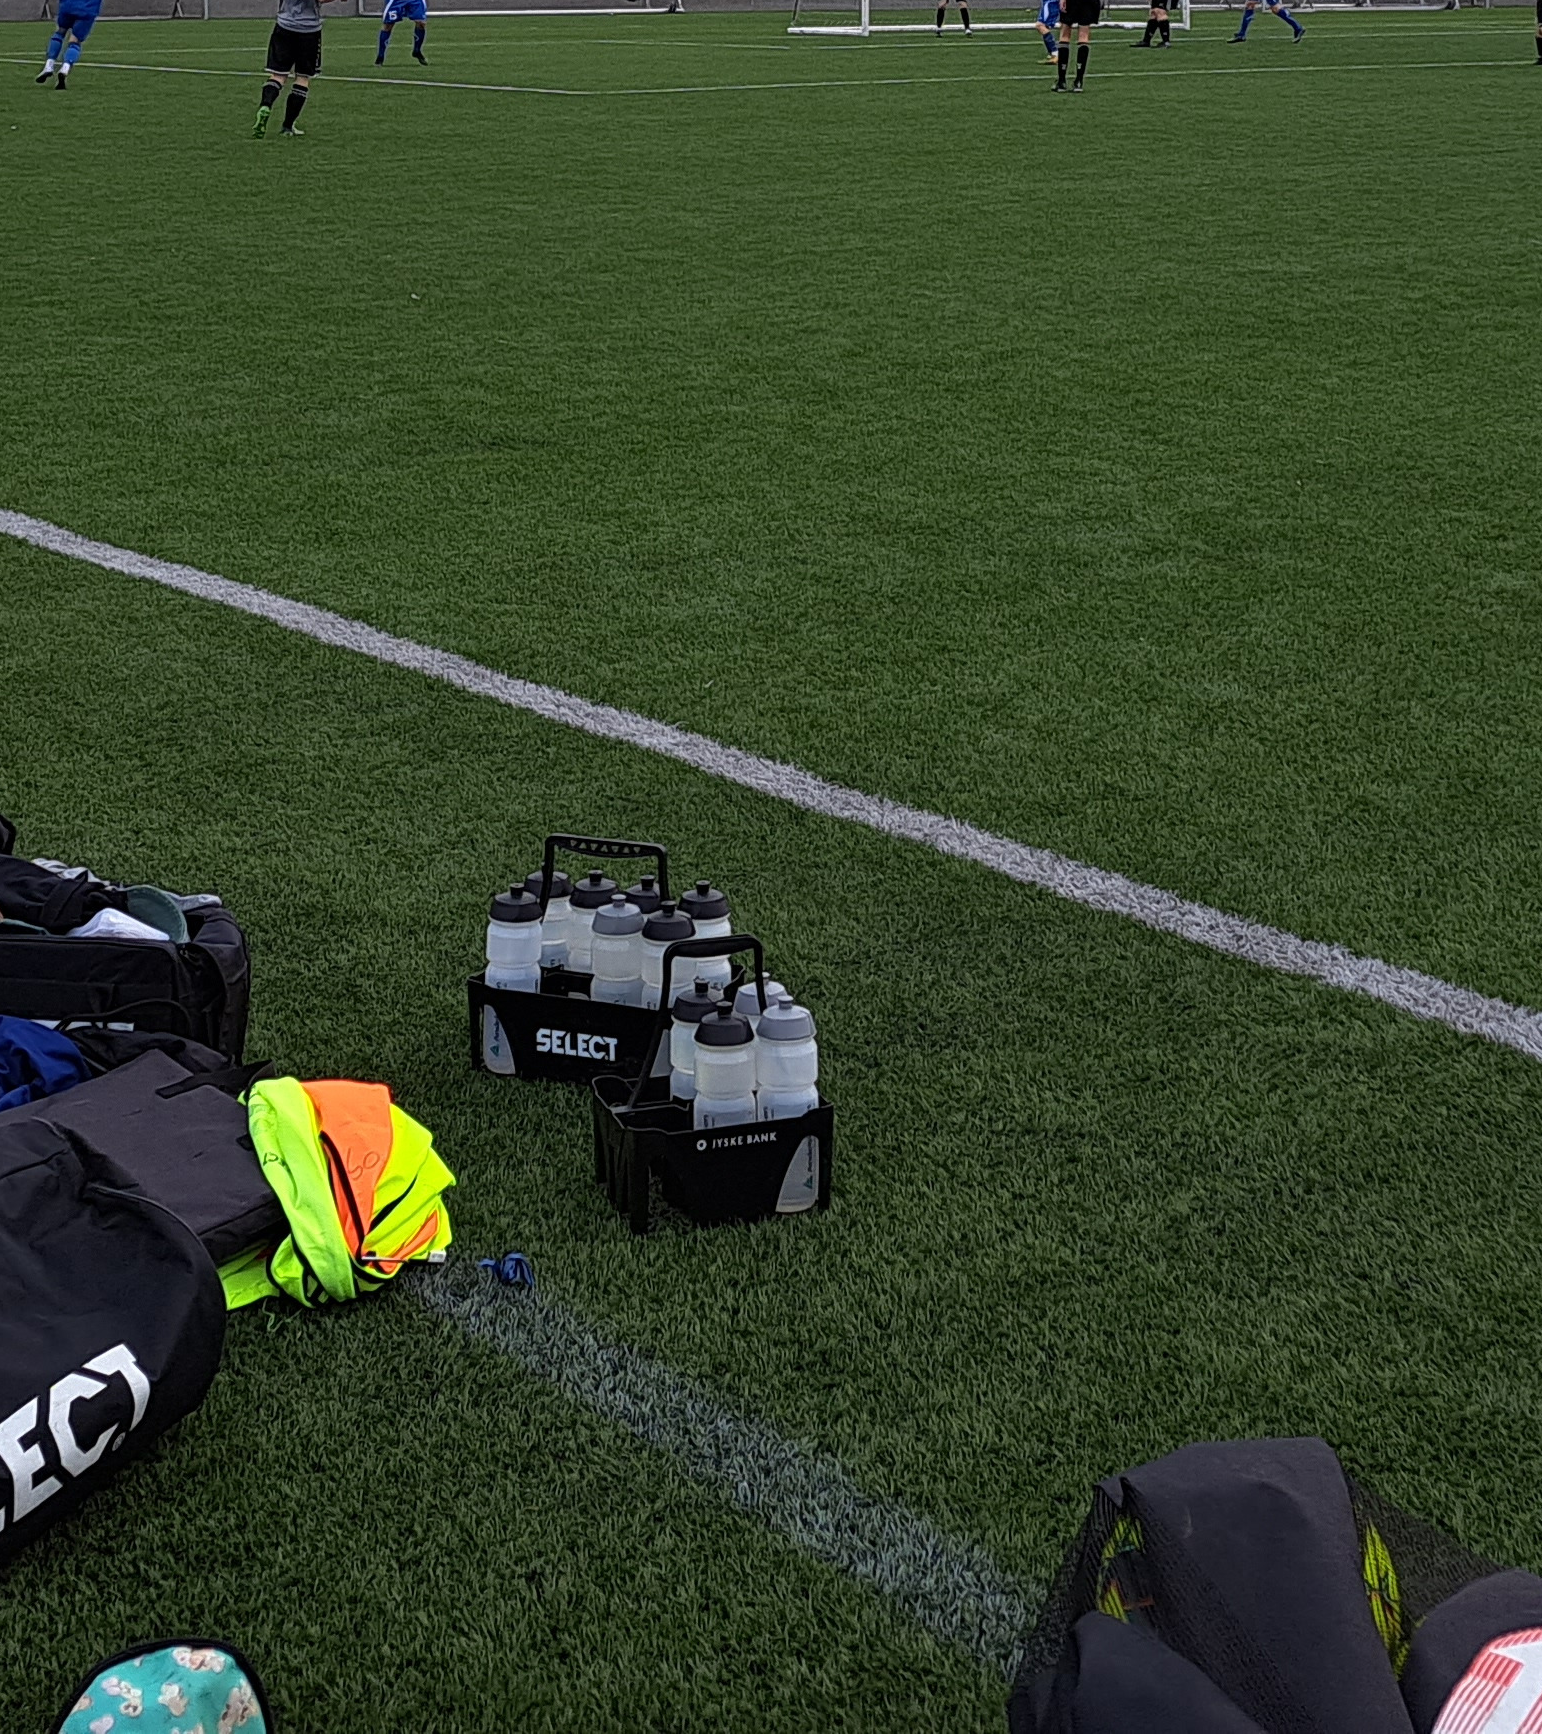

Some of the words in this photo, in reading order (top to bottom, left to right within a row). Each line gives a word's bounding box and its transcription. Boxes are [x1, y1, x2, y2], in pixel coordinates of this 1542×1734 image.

[536, 1028, 618, 1061] SELECT
[712, 1136, 743, 1149] JYSKE
[746, 1132, 777, 1145] BANK
